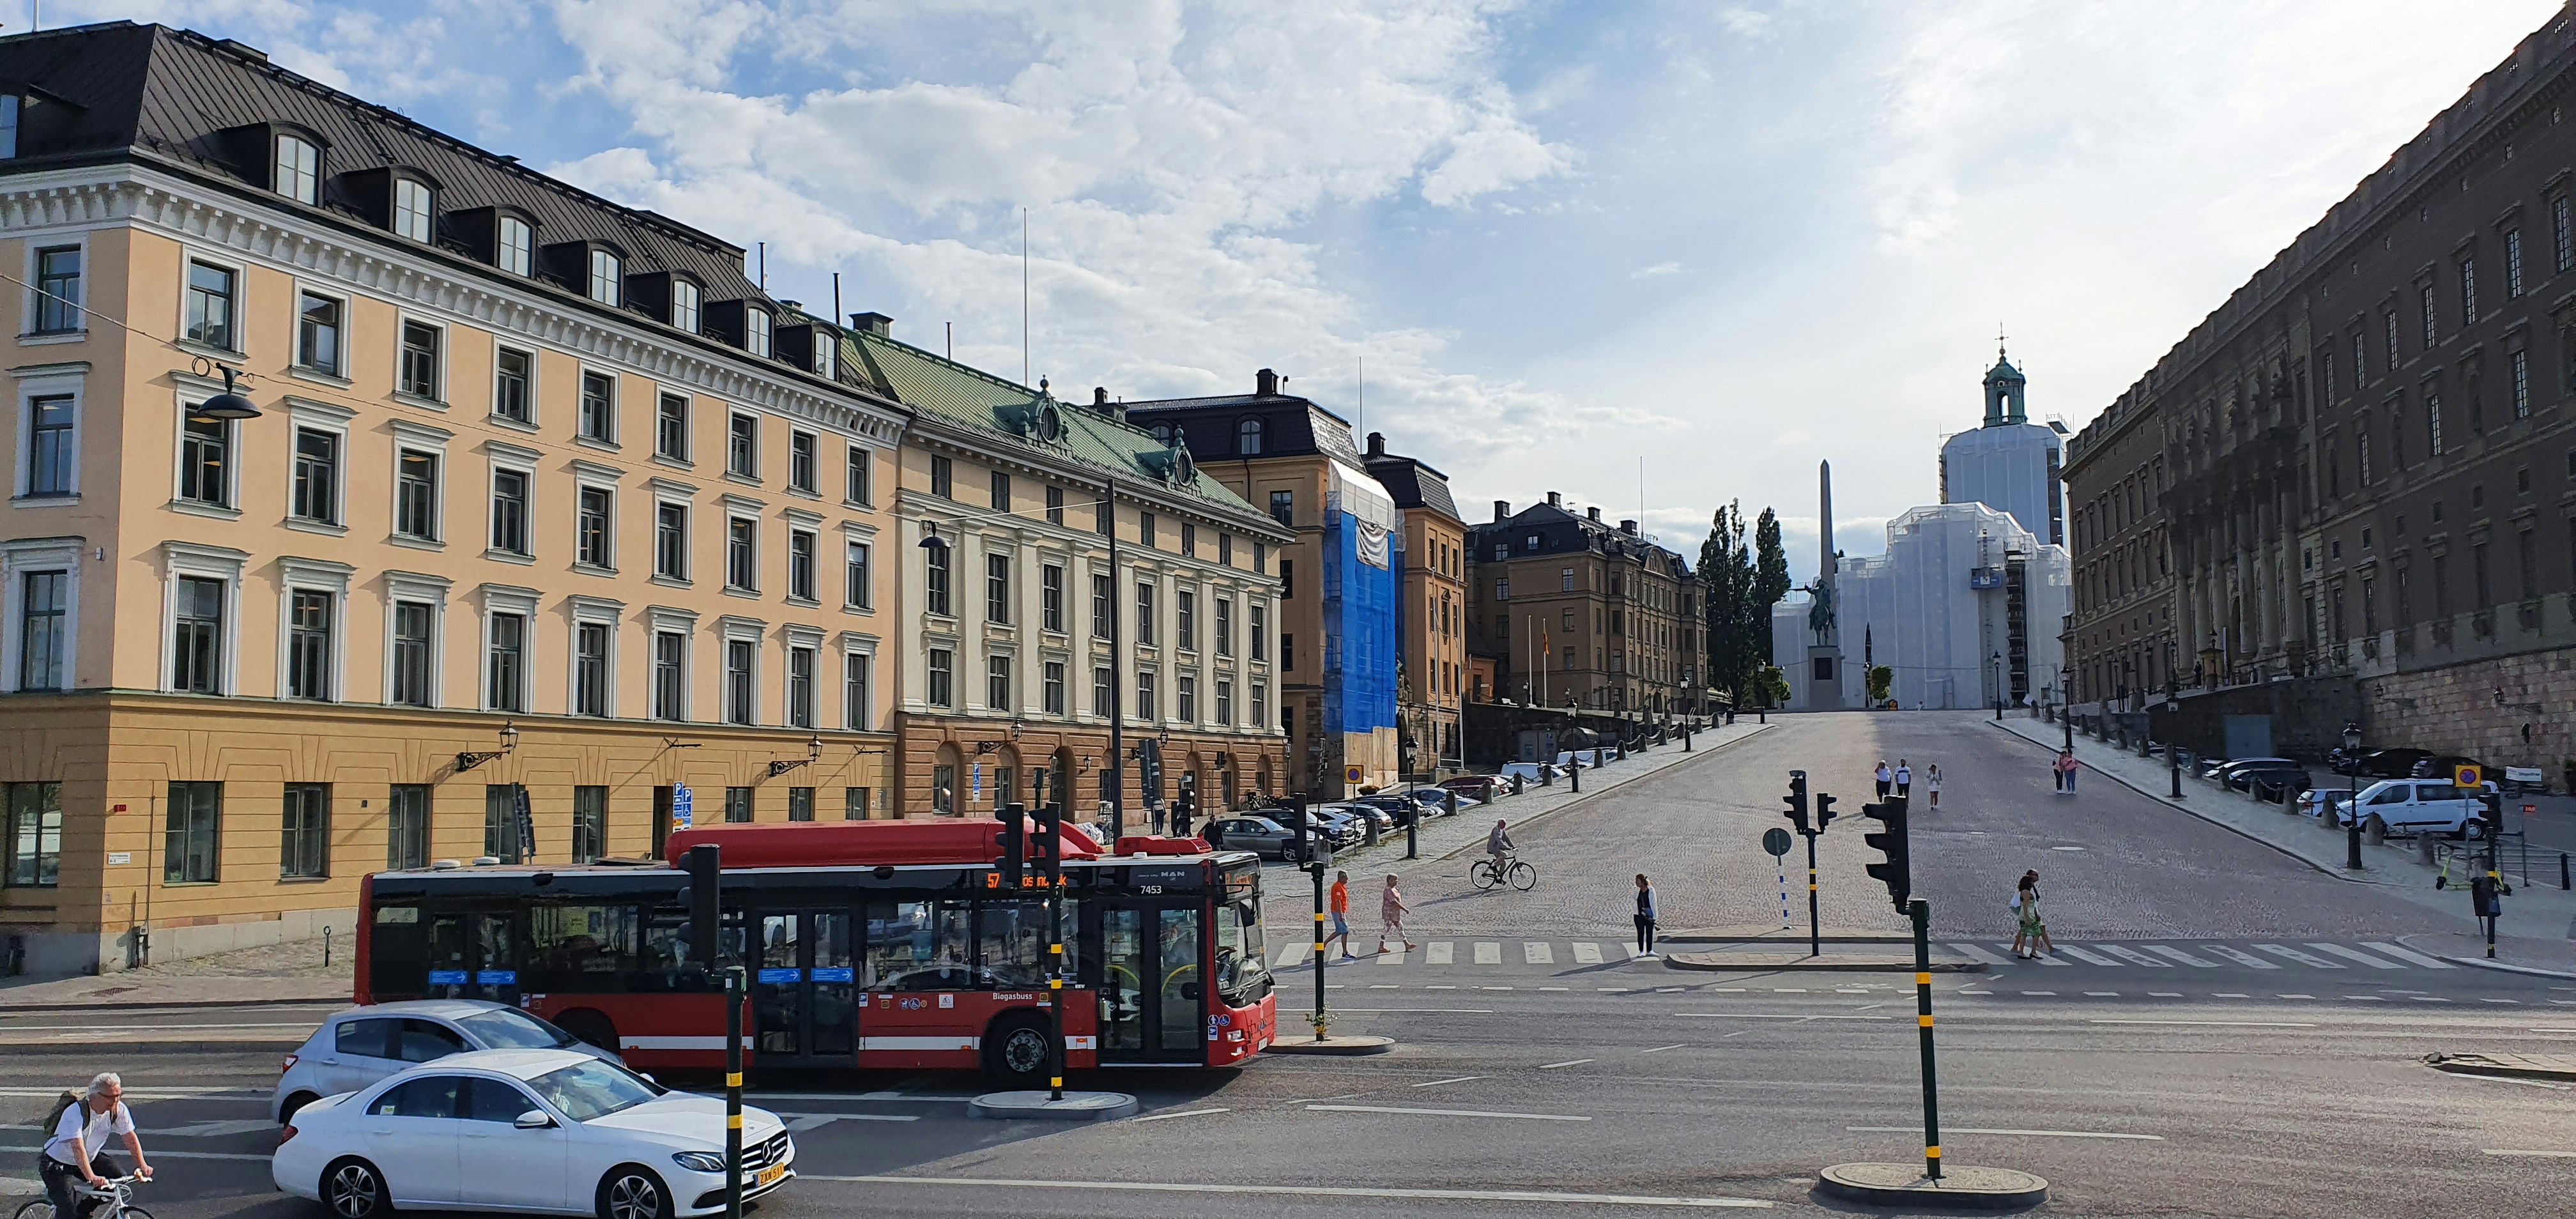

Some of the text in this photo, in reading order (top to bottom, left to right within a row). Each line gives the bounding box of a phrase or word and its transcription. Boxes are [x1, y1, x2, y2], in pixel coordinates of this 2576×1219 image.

[974, 763, 979, 772] P
[675, 783, 682, 795] P
[685, 790, 691, 801] P
[988, 873, 1000, 888] 57
[1140, 885, 1162, 894] 7453
[992, 992, 1033, 1001] Biogasbuss
[760, 1165, 783, 1184] ZXN 511
